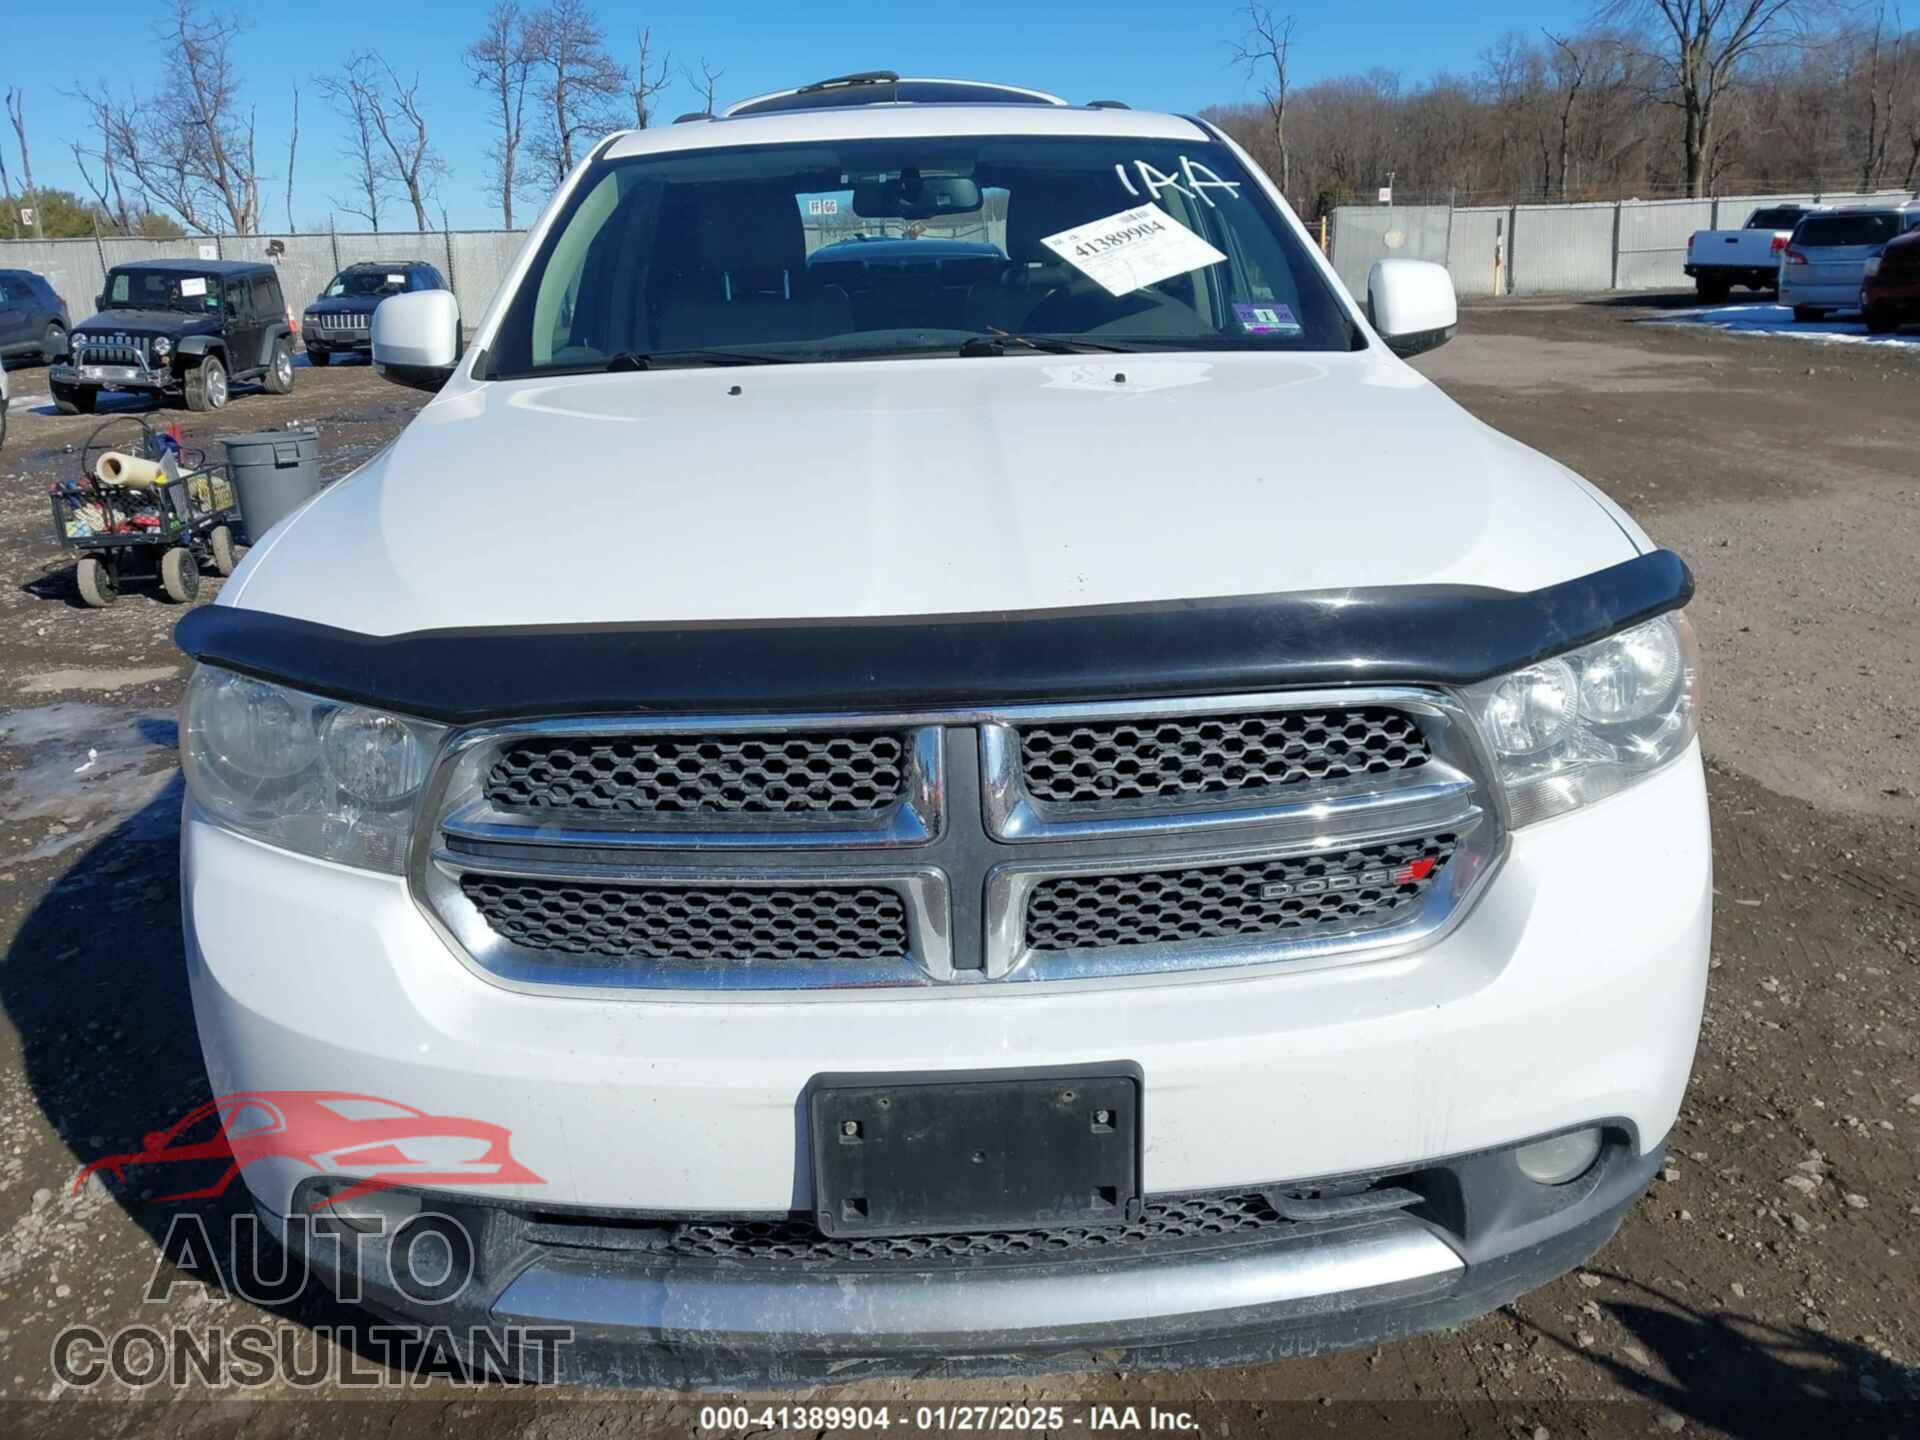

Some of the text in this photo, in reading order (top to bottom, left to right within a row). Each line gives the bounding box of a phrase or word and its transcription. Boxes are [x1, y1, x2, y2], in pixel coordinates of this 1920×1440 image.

[1115, 155, 1240, 207] IAA
[1074, 219, 1166, 257] 41389904
[1262, 864, 1416, 900] DODGE
